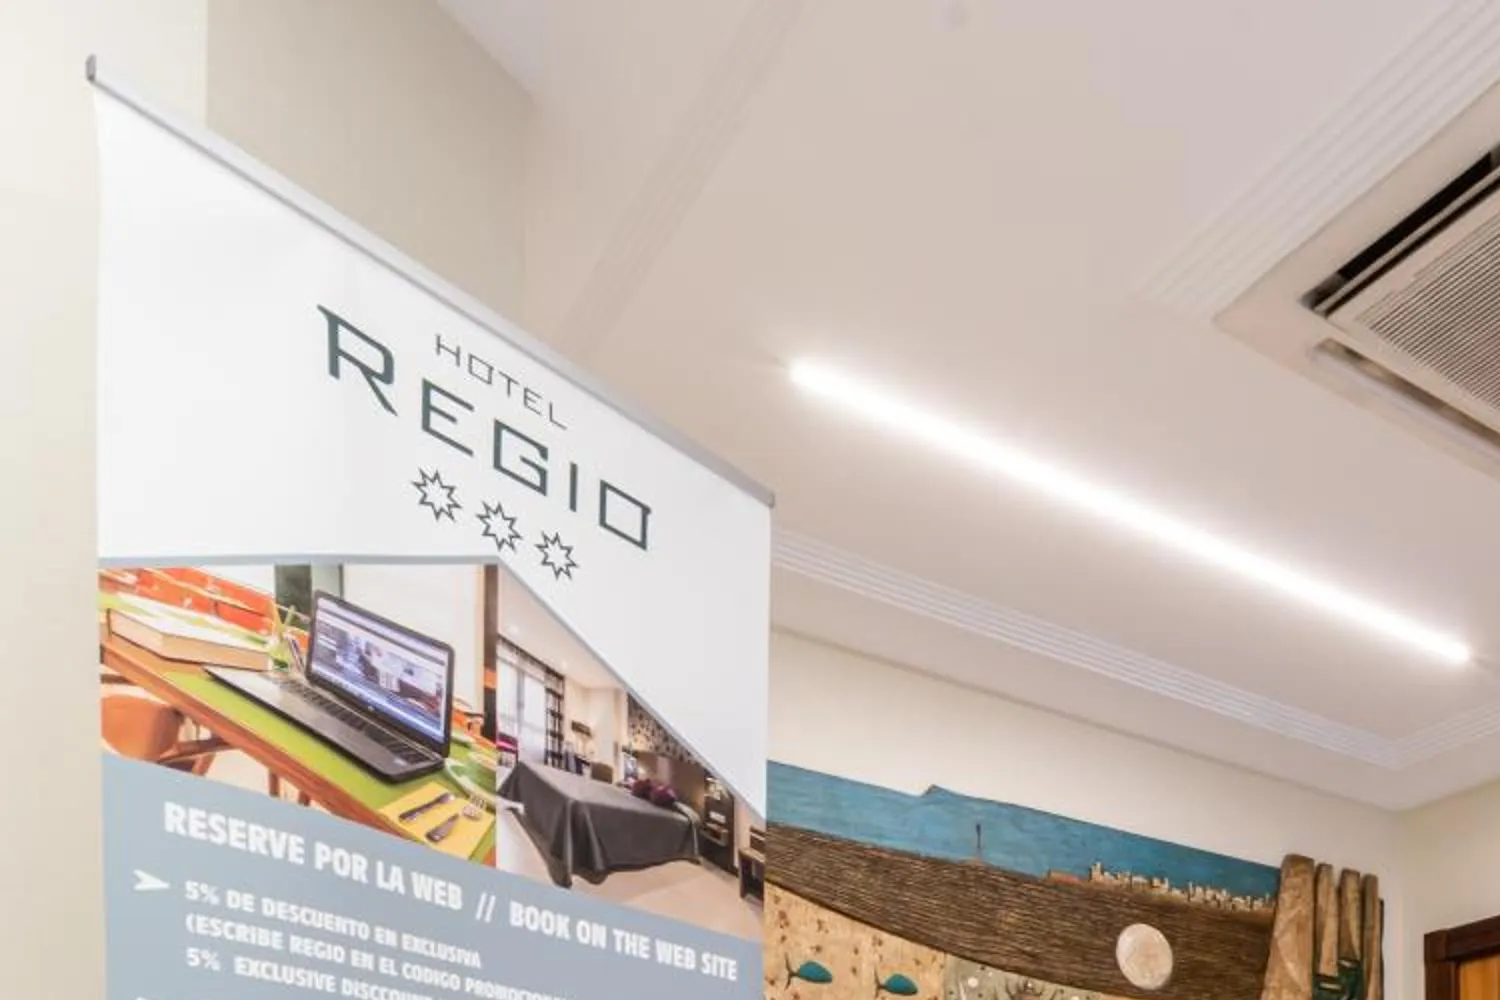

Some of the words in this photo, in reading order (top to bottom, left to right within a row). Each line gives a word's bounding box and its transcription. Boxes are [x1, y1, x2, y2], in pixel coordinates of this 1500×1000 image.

[435, 333, 567, 429] HOTEL
[316, 304, 651, 551] REGIO
[163, 801, 305, 865] RESERVE
[314, 841, 368, 884] POR
[376, 861, 405, 895] LA
[412, 871, 463, 910] WEB
[475, 892, 496, 923] //
[509, 901, 570, 941] BOOK
[576, 920, 607, 950] ON
[613, 929, 650, 959] THE
[655, 940, 696, 970] WEB
[701, 952, 737, 981] SITE
[185, 880, 220, 905] 5%
[226, 889, 255, 913] DE
[261, 897, 369, 941] DESCUENTO
[374, 926, 397, 948] EN
[402, 932, 482, 969] EXCLUSIVA
[185, 913, 284, 950] (ESCRIBE
[289, 934, 345, 964] REGIO
[350, 949, 374, 971] EN
[379, 956, 399, 977] EL
[186, 946, 221, 972] 5%
[233, 955, 336, 993] EXCLUSIVE
